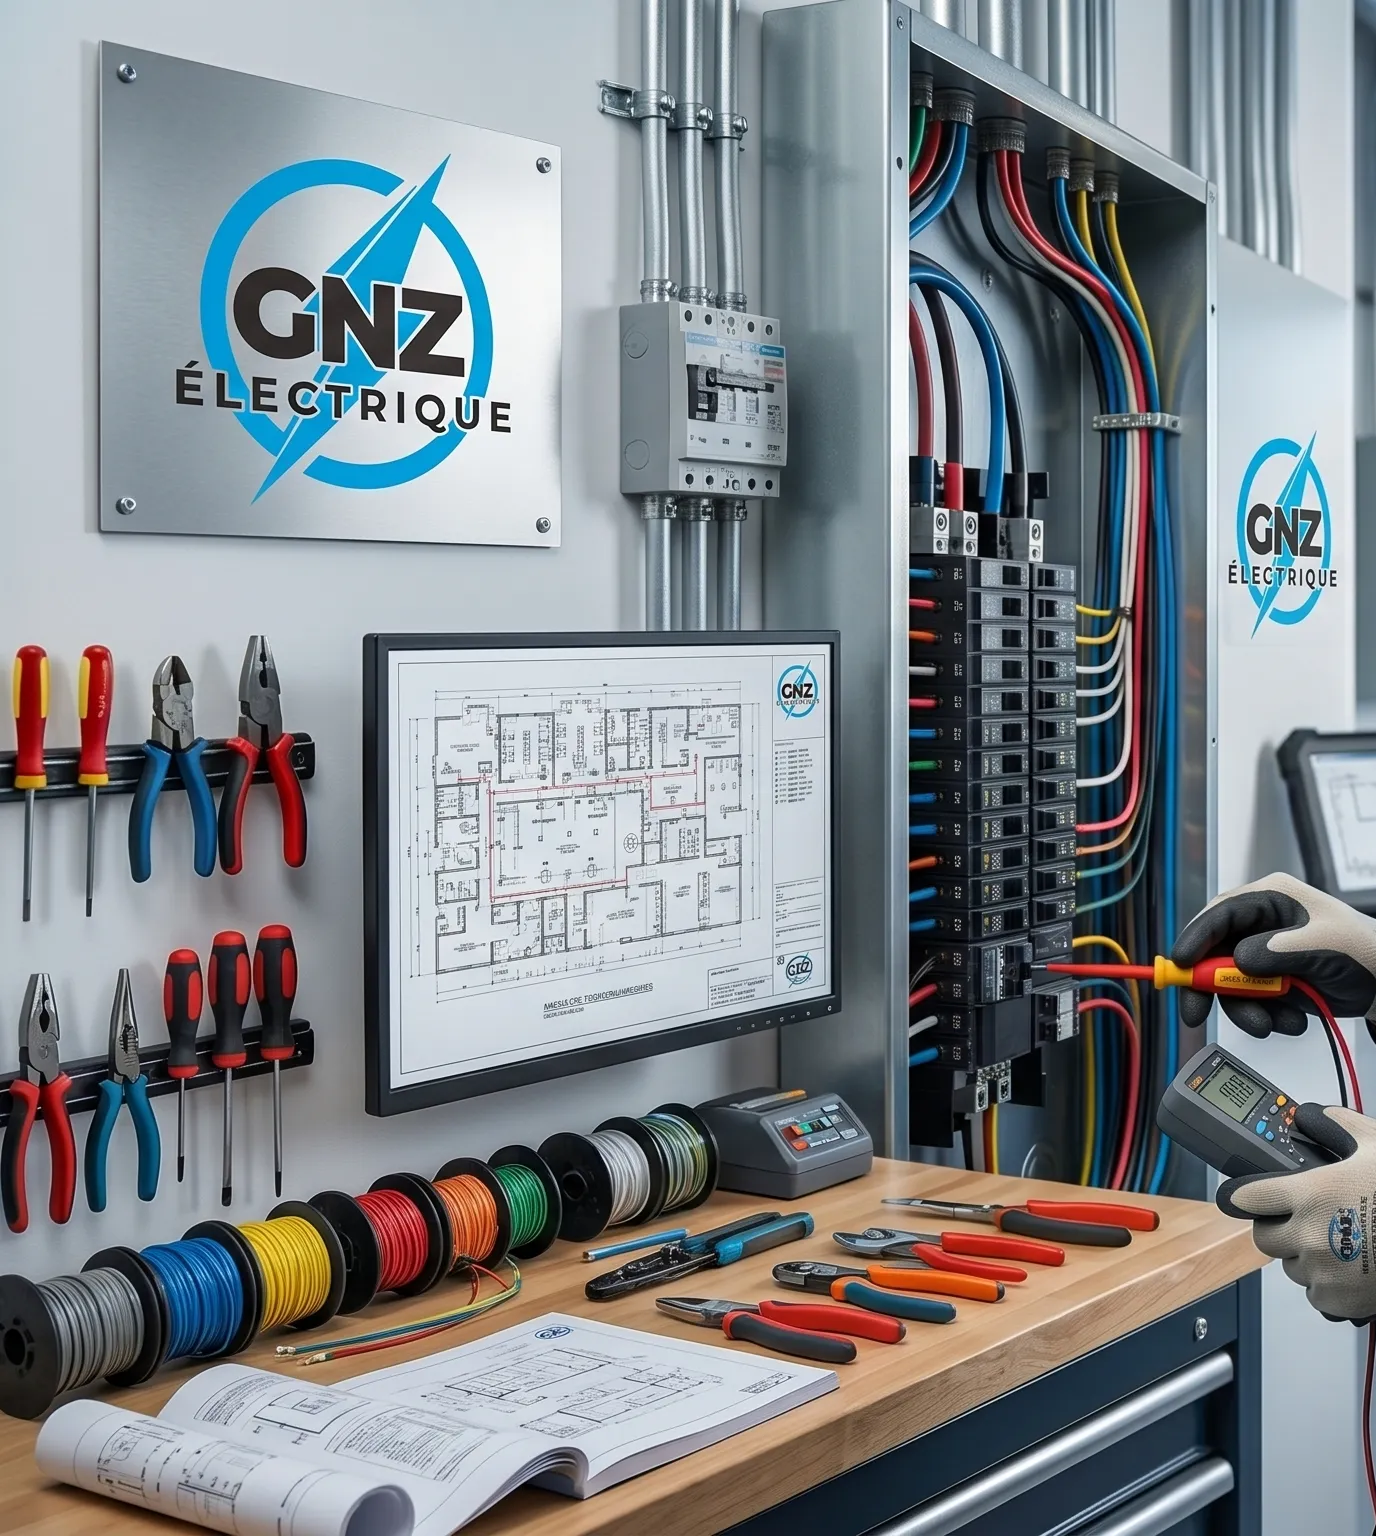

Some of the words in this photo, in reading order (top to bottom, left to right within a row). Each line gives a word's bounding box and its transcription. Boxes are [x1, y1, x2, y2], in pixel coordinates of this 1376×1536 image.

[233, 266, 465, 378] GNZ
[175, 360, 512, 434] ÉLECTRIQUE
[1246, 503, 1322, 558] GNZ
[1228, 560, 1338, 590] ÉLECTRIQUE
[781, 682, 814, 699] GNZ
